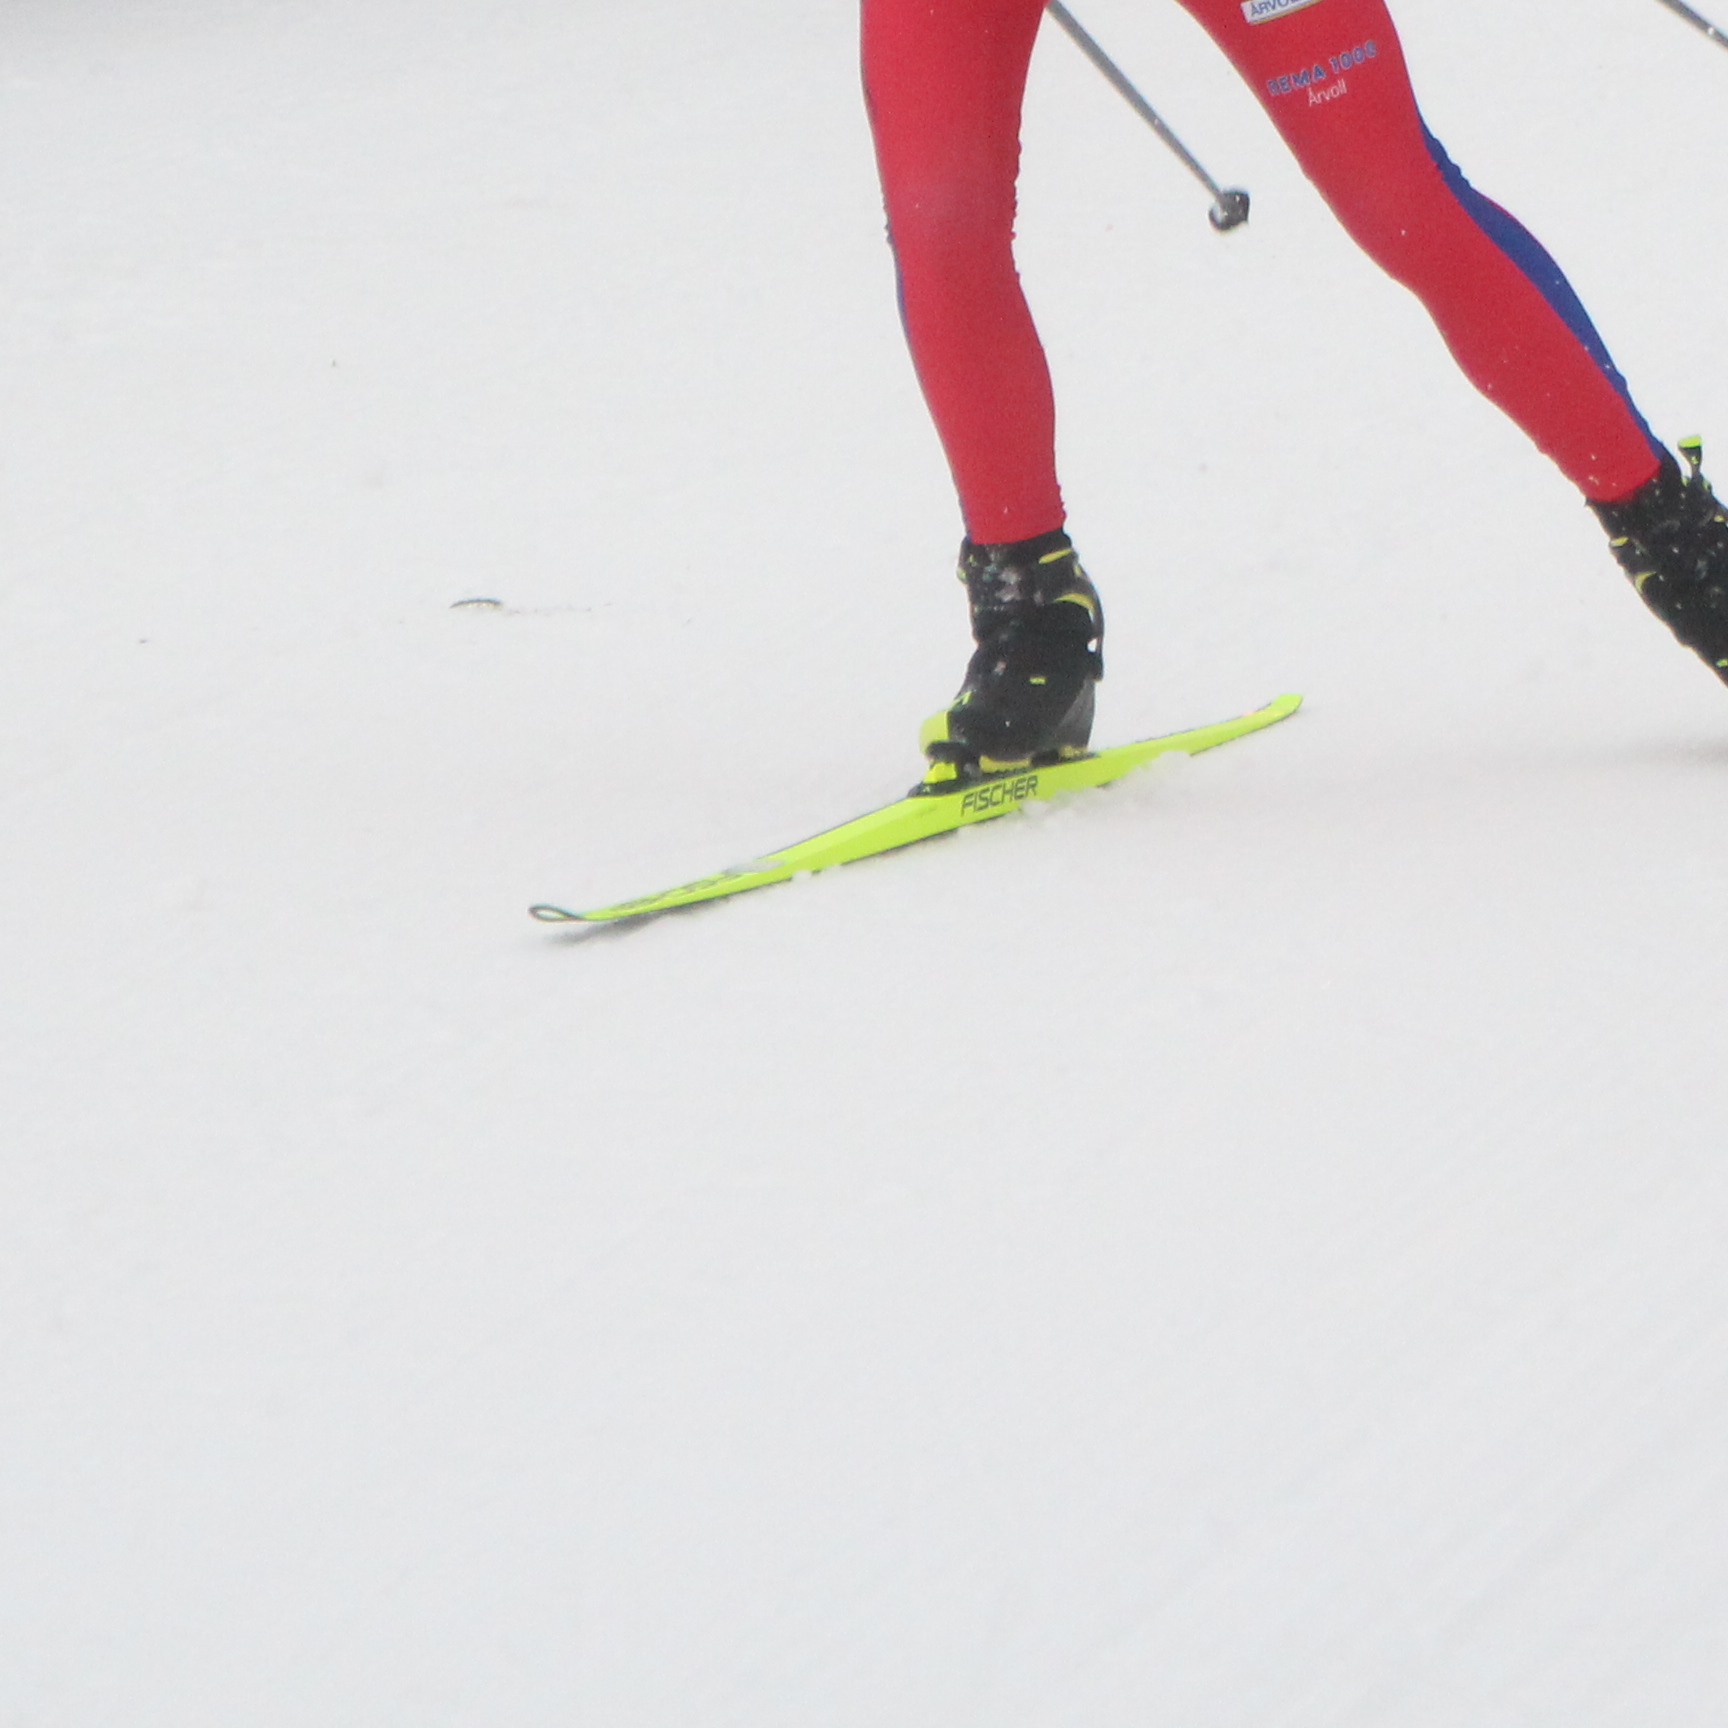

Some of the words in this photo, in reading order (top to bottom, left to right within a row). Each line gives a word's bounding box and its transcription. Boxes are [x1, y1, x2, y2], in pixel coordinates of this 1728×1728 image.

[1267, 63, 1327, 96] REMA
[1329, 40, 1378, 74] 1000
[1308, 78, 1348, 108] Årvoll
[960, 774, 1039, 817] FISCHER
